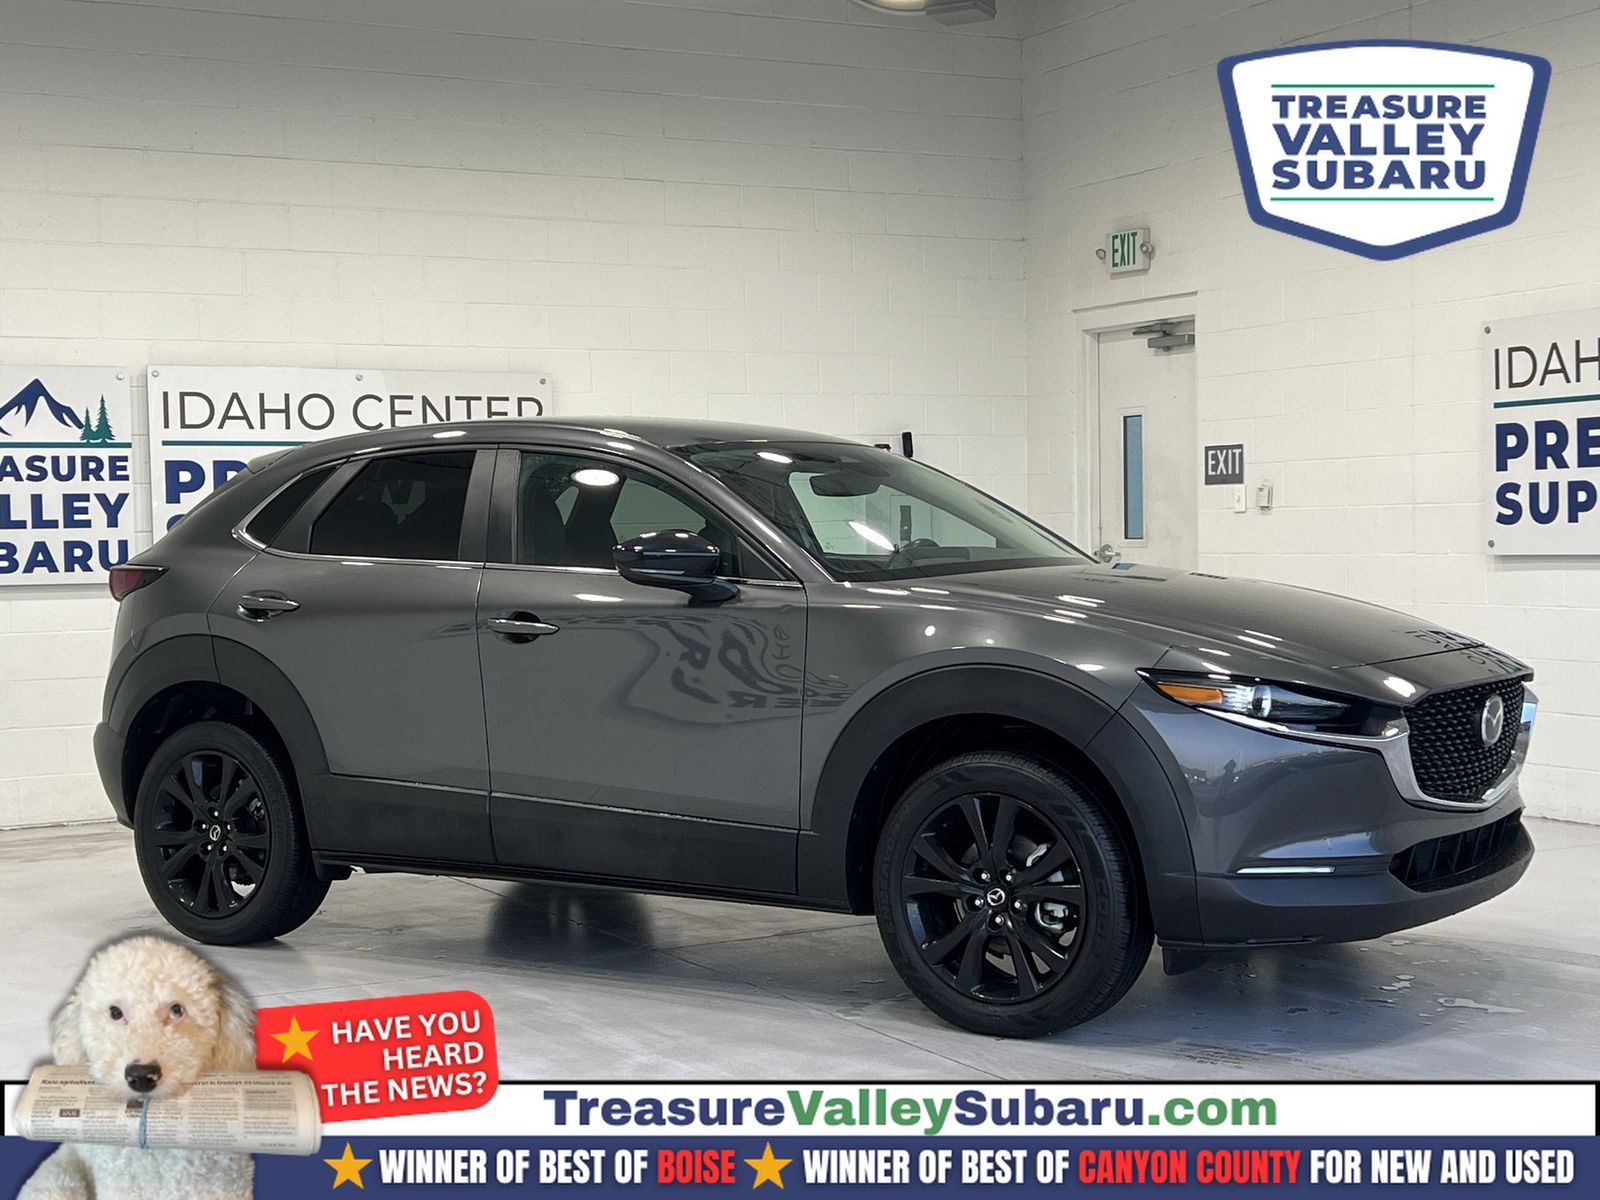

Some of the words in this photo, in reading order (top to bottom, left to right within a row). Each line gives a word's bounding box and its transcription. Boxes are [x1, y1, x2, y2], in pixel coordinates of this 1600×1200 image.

[1111, 231, 1138, 268] EXIT
[162, 391, 335, 430] IDAHO
[1207, 448, 1242, 475] EXIT
[1495, 417, 1600, 472] PRE
[0, 455, 130, 482] ASURE
[0, 493, 130, 529] LLEY
[1496, 480, 1598, 525] SUP
